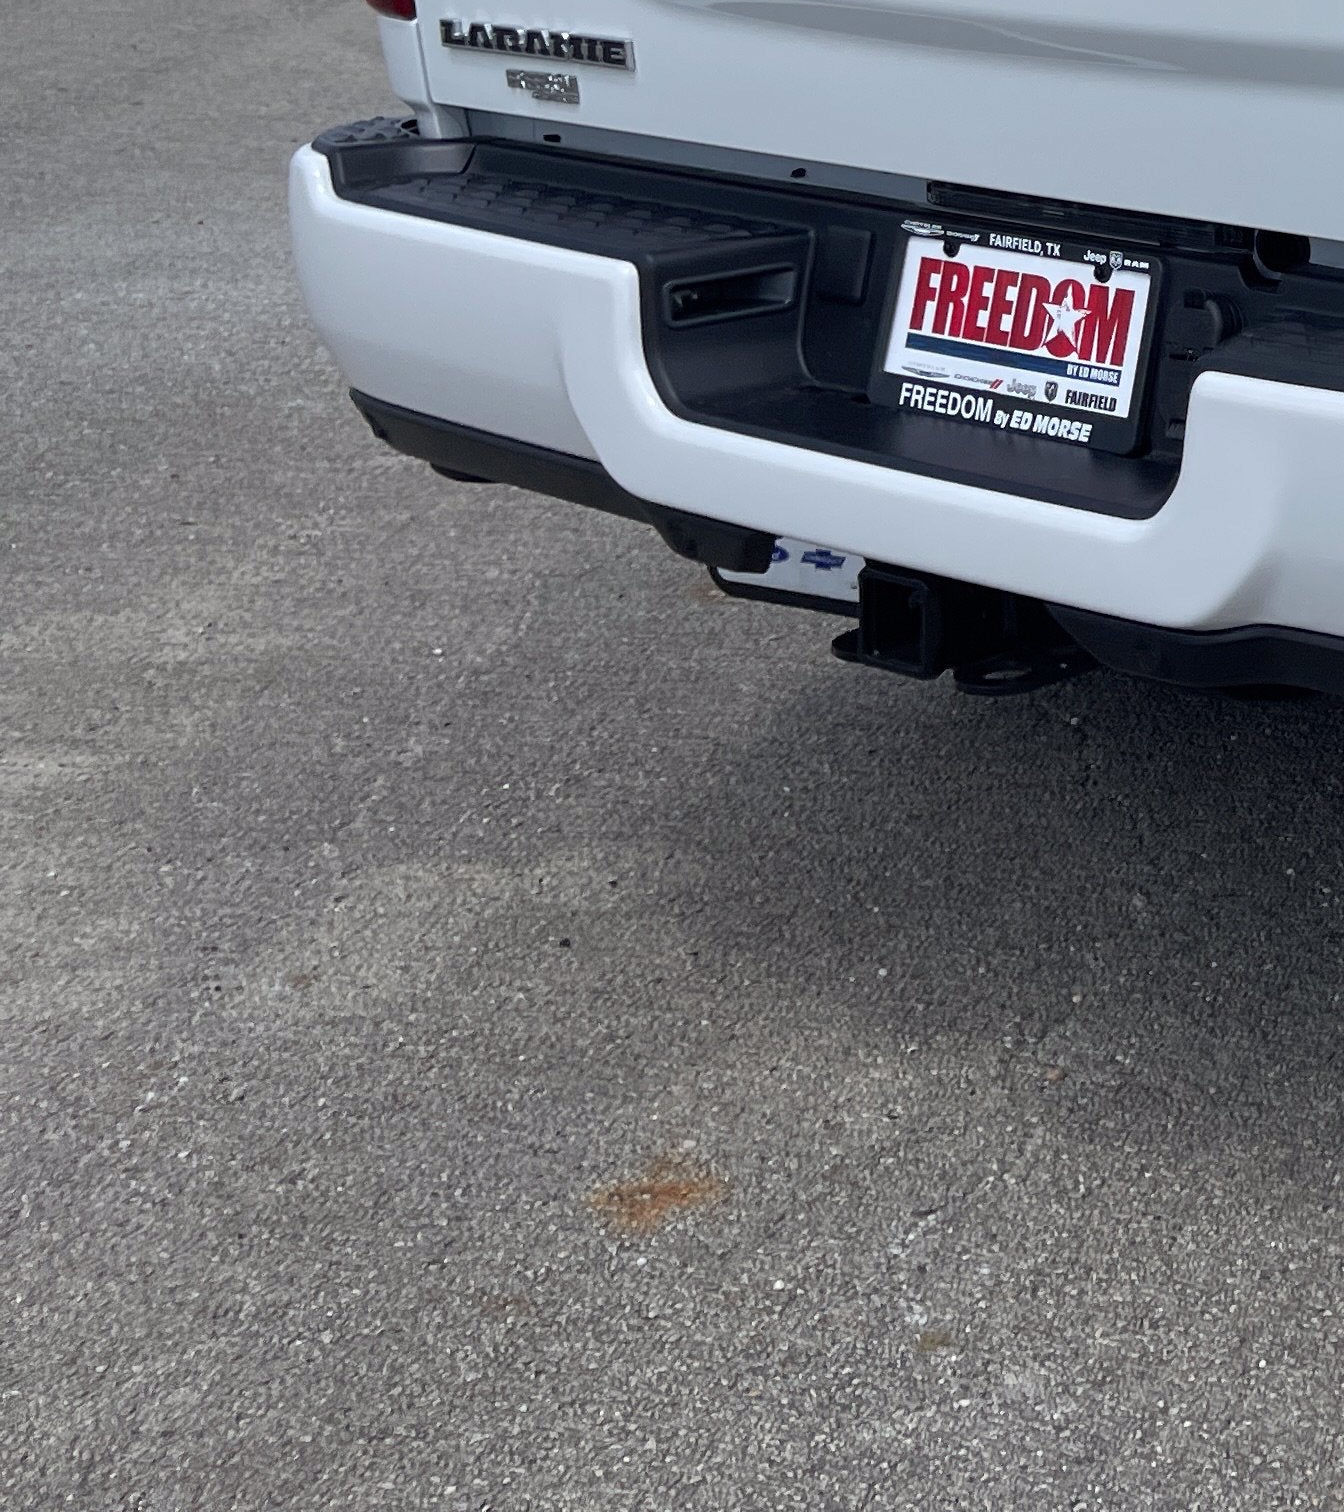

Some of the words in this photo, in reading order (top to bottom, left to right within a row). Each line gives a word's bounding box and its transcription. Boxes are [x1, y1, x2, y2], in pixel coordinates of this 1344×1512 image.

[440, 18, 636, 72] LARAMIE
[989, 233, 1044, 256] FAIRFIELD,
[1046, 242, 1061, 257] TX
[1083, 249, 1107, 265] Jeep
[1124, 259, 1150, 269] RAM
[909, 256, 1136, 367] FREEDOM
[1090, 368, 1119, 384] MORSE
[1065, 389, 1118, 412] FAIRFIELD
[899, 382, 994, 422] FREEDOM
[1009, 409, 1034, 431] ED
[1032, 414, 1093, 443] MORSE
